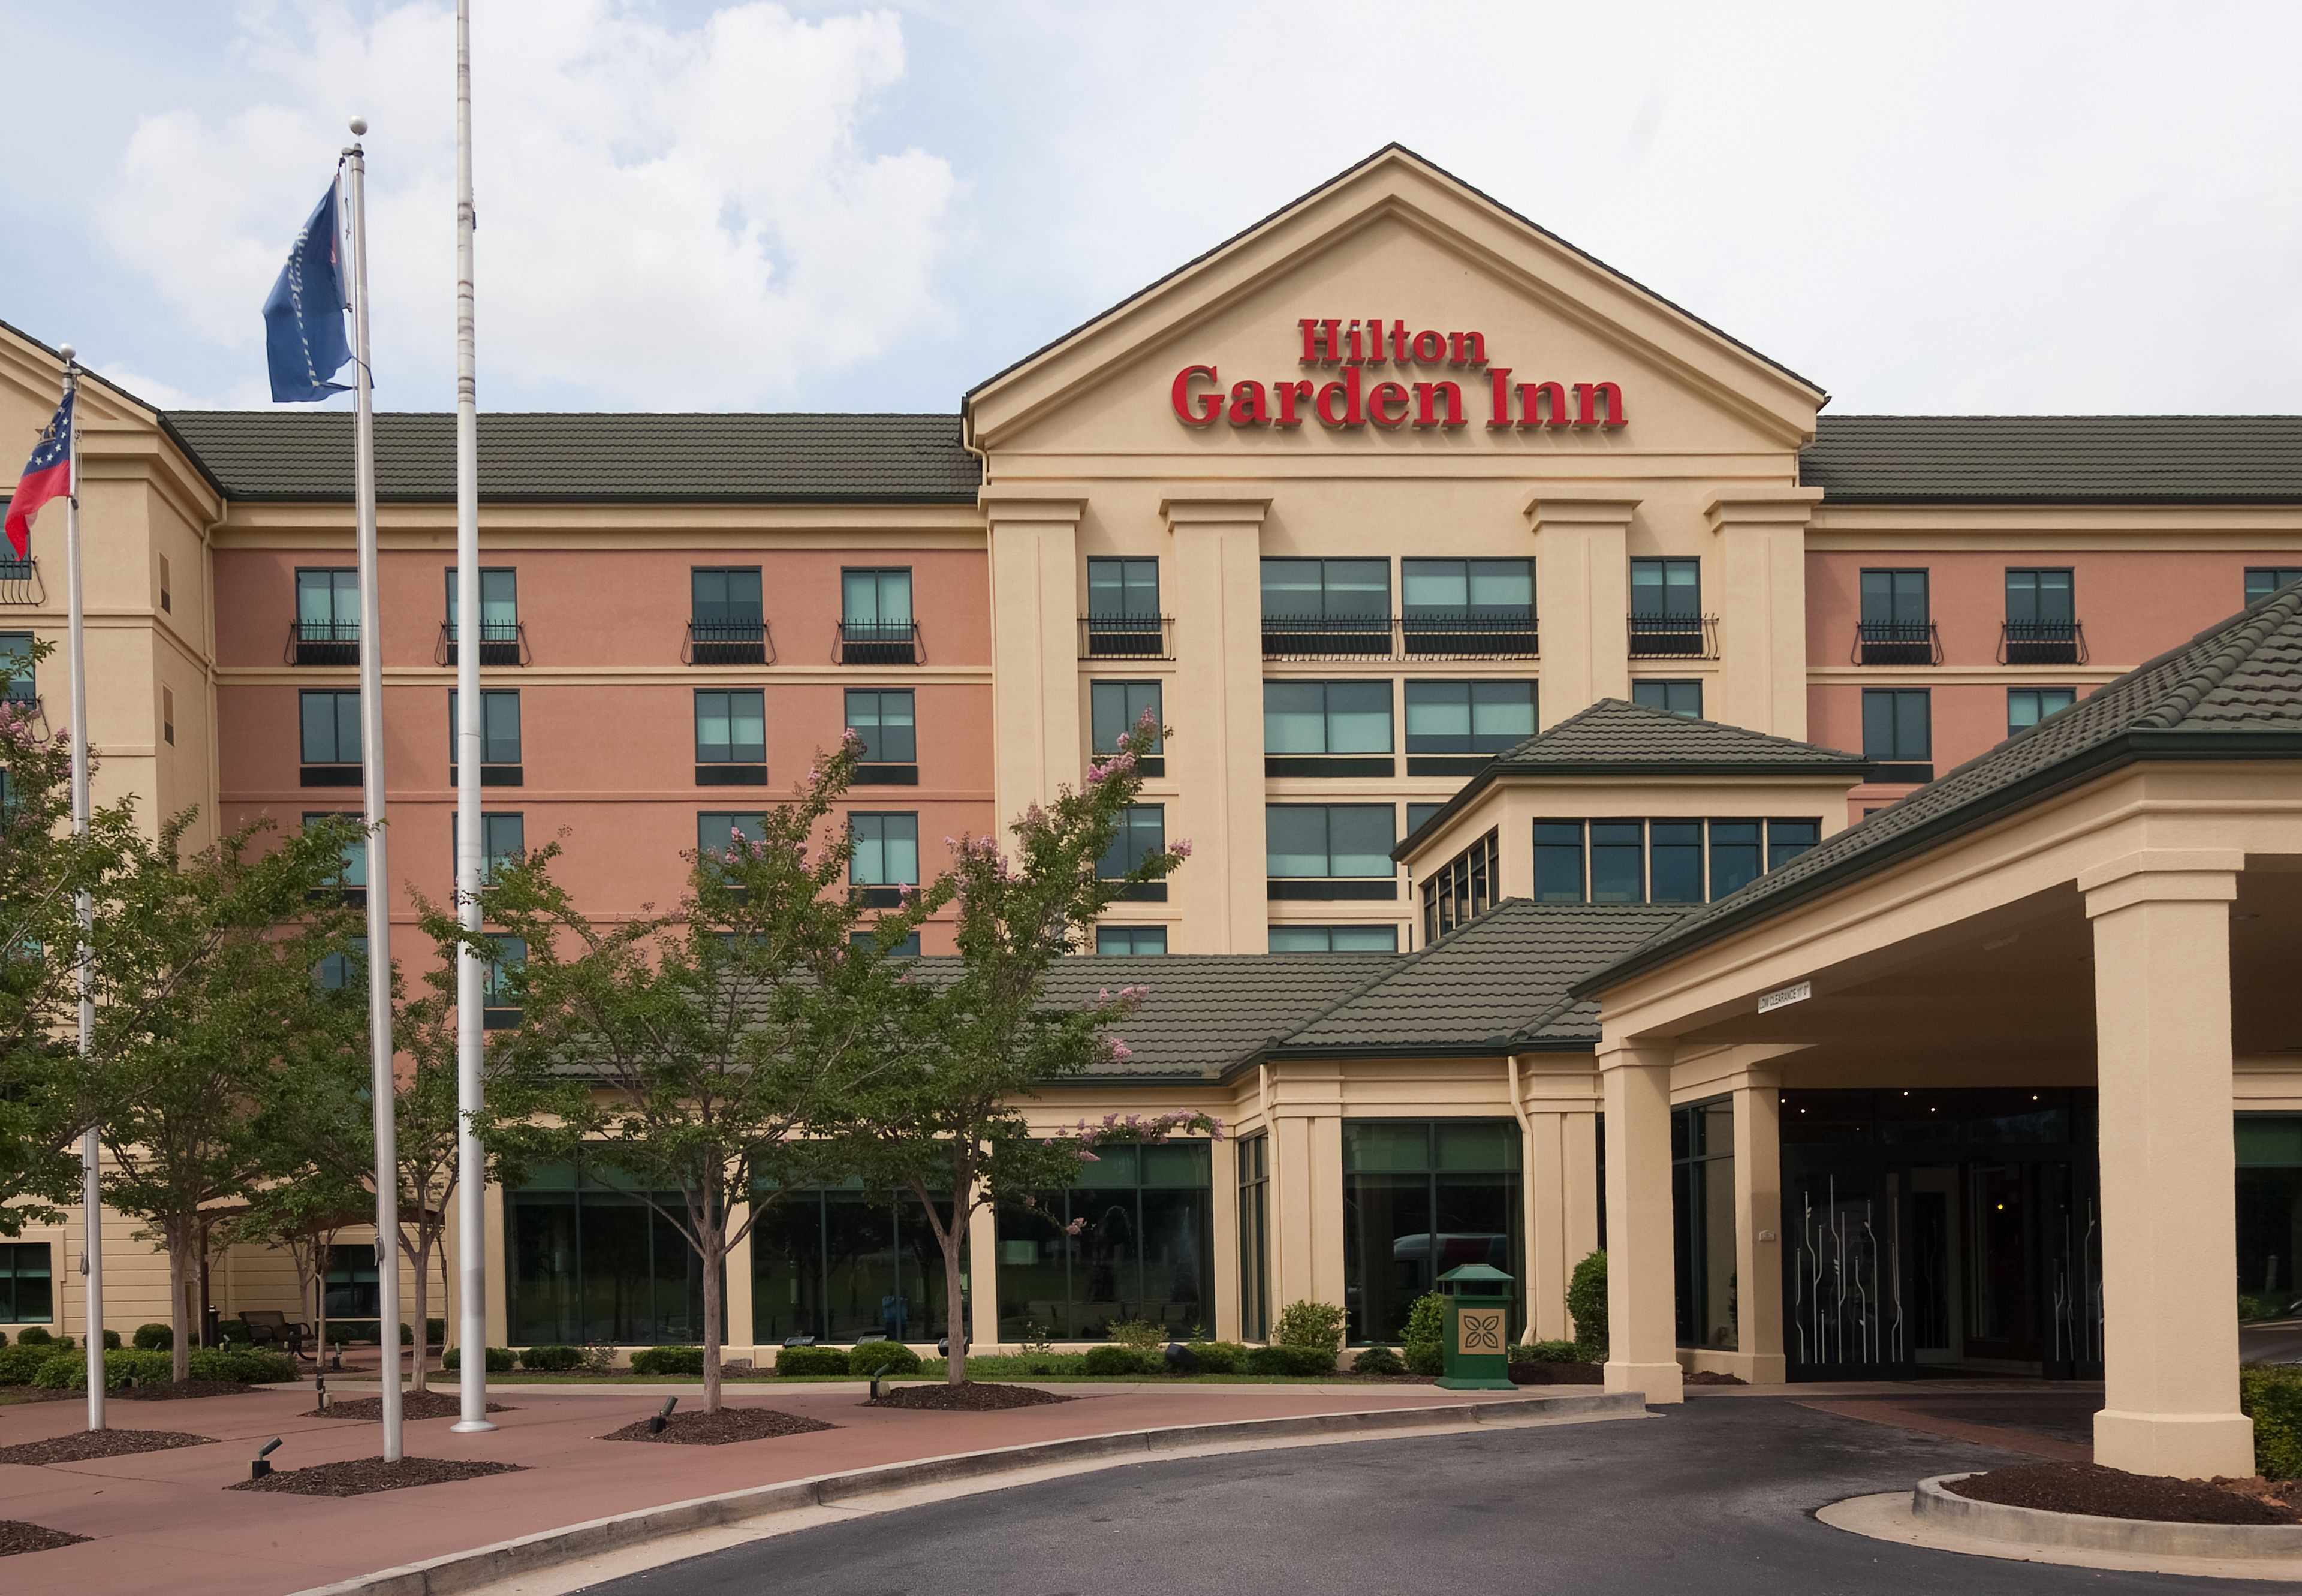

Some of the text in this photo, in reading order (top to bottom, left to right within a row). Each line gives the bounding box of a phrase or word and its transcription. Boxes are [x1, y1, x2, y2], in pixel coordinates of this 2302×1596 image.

[1298, 318, 1489, 366] Hilton
[1171, 365, 1629, 429] Garden Inn
[1770, 988, 1796, 1006] CLEARANCE
